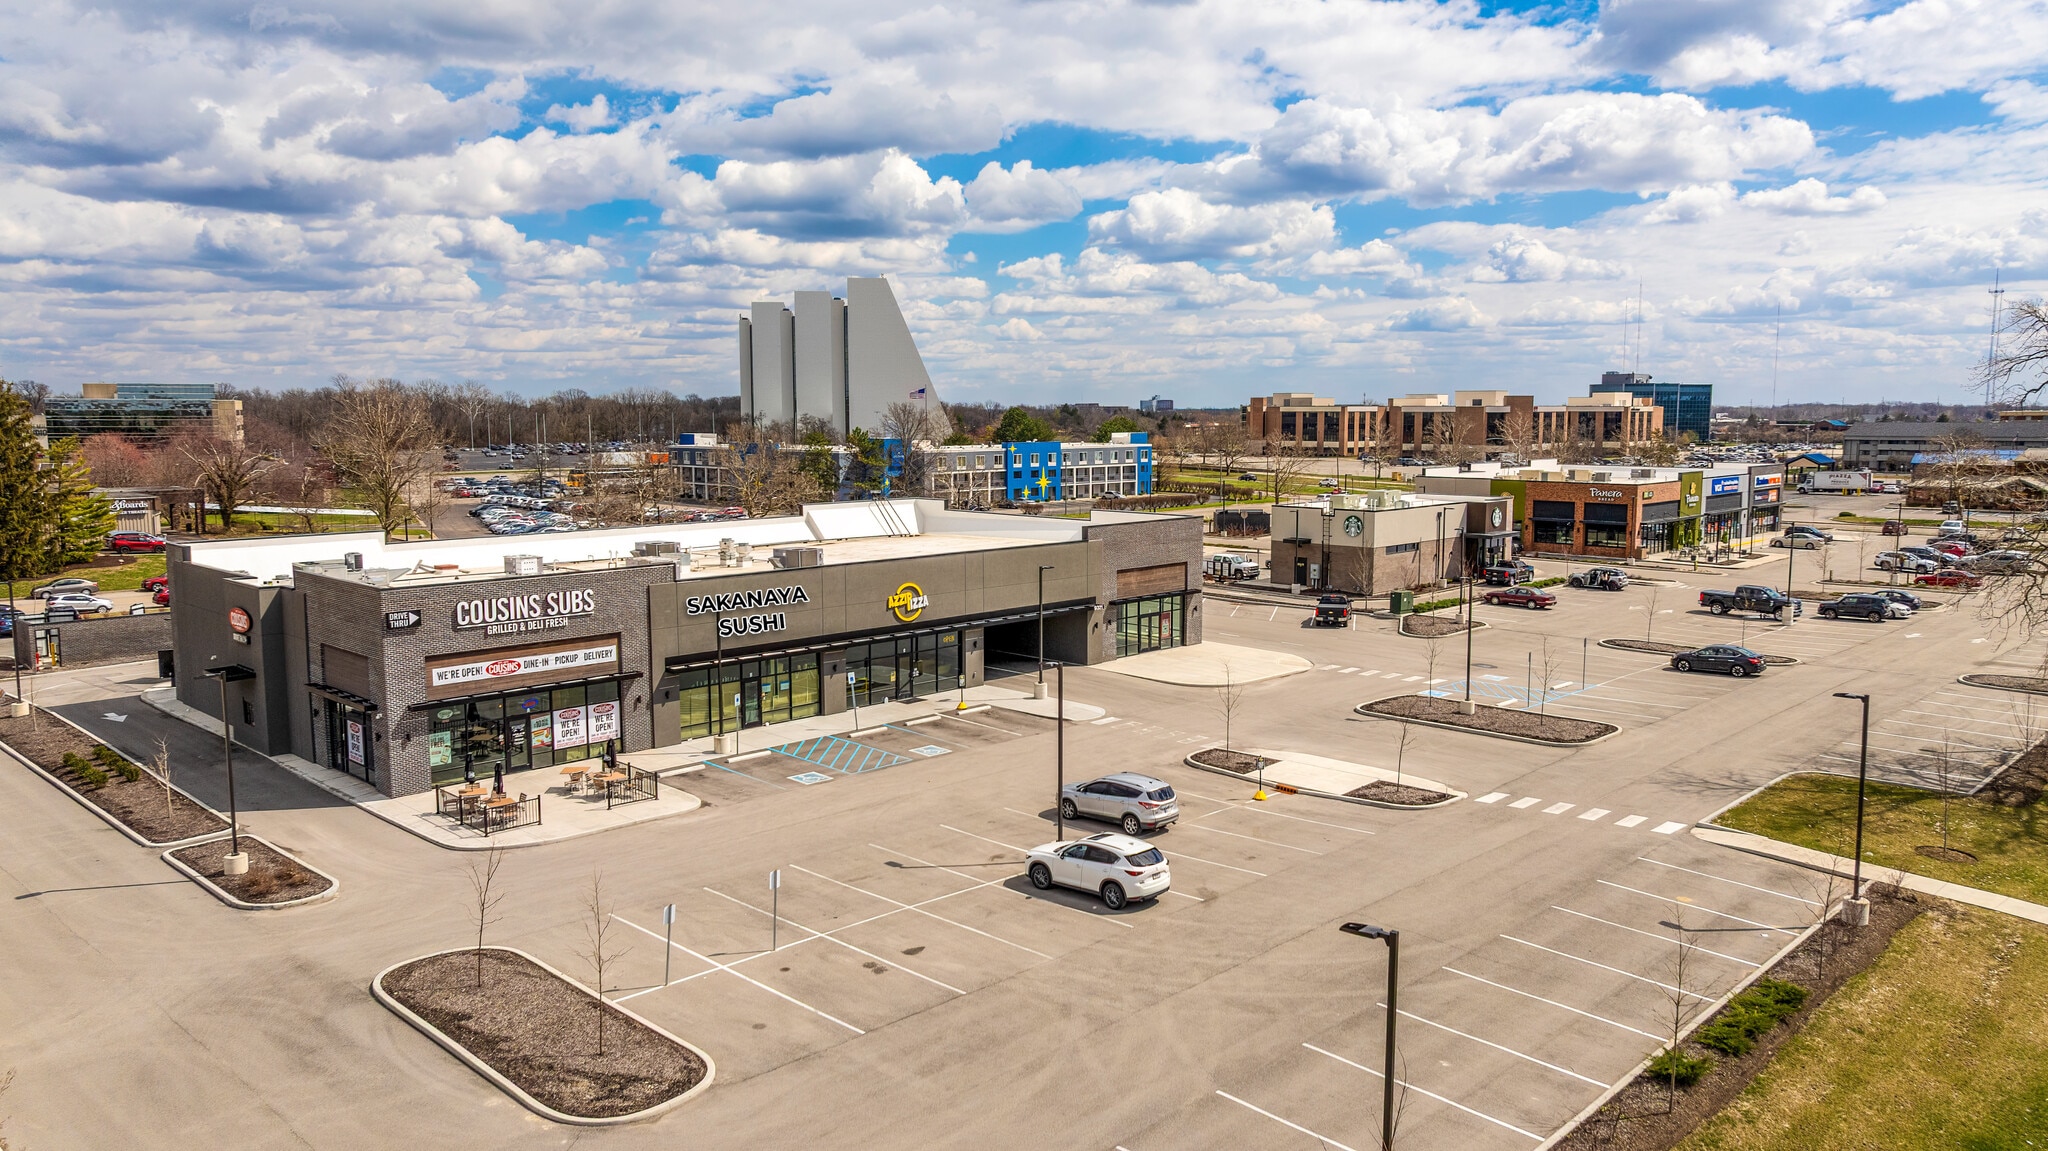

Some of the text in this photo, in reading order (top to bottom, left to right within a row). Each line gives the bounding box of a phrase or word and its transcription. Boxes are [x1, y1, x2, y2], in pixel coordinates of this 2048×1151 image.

[1589, 487, 1622, 497] Panera
[686, 585, 810, 615] SAKANAYA
[457, 589, 594, 625] COUSINS SUBS
[389, 611, 409, 621] DRIVE
[390, 619, 409, 628] THRU
[487, 617, 569, 635] GRILLED & DELI FRESH
[718, 612, 786, 637] SUSHI
[437, 649, 613, 681] WE'RE OPEN! COUSINS DINE-IN PICKUP DELIVERY
[595, 713, 614, 723] WE'RE
[561, 719, 580, 729] WE'RE
[595, 722, 614, 732] OPEN!
[561, 728, 580, 738] OPEN!
